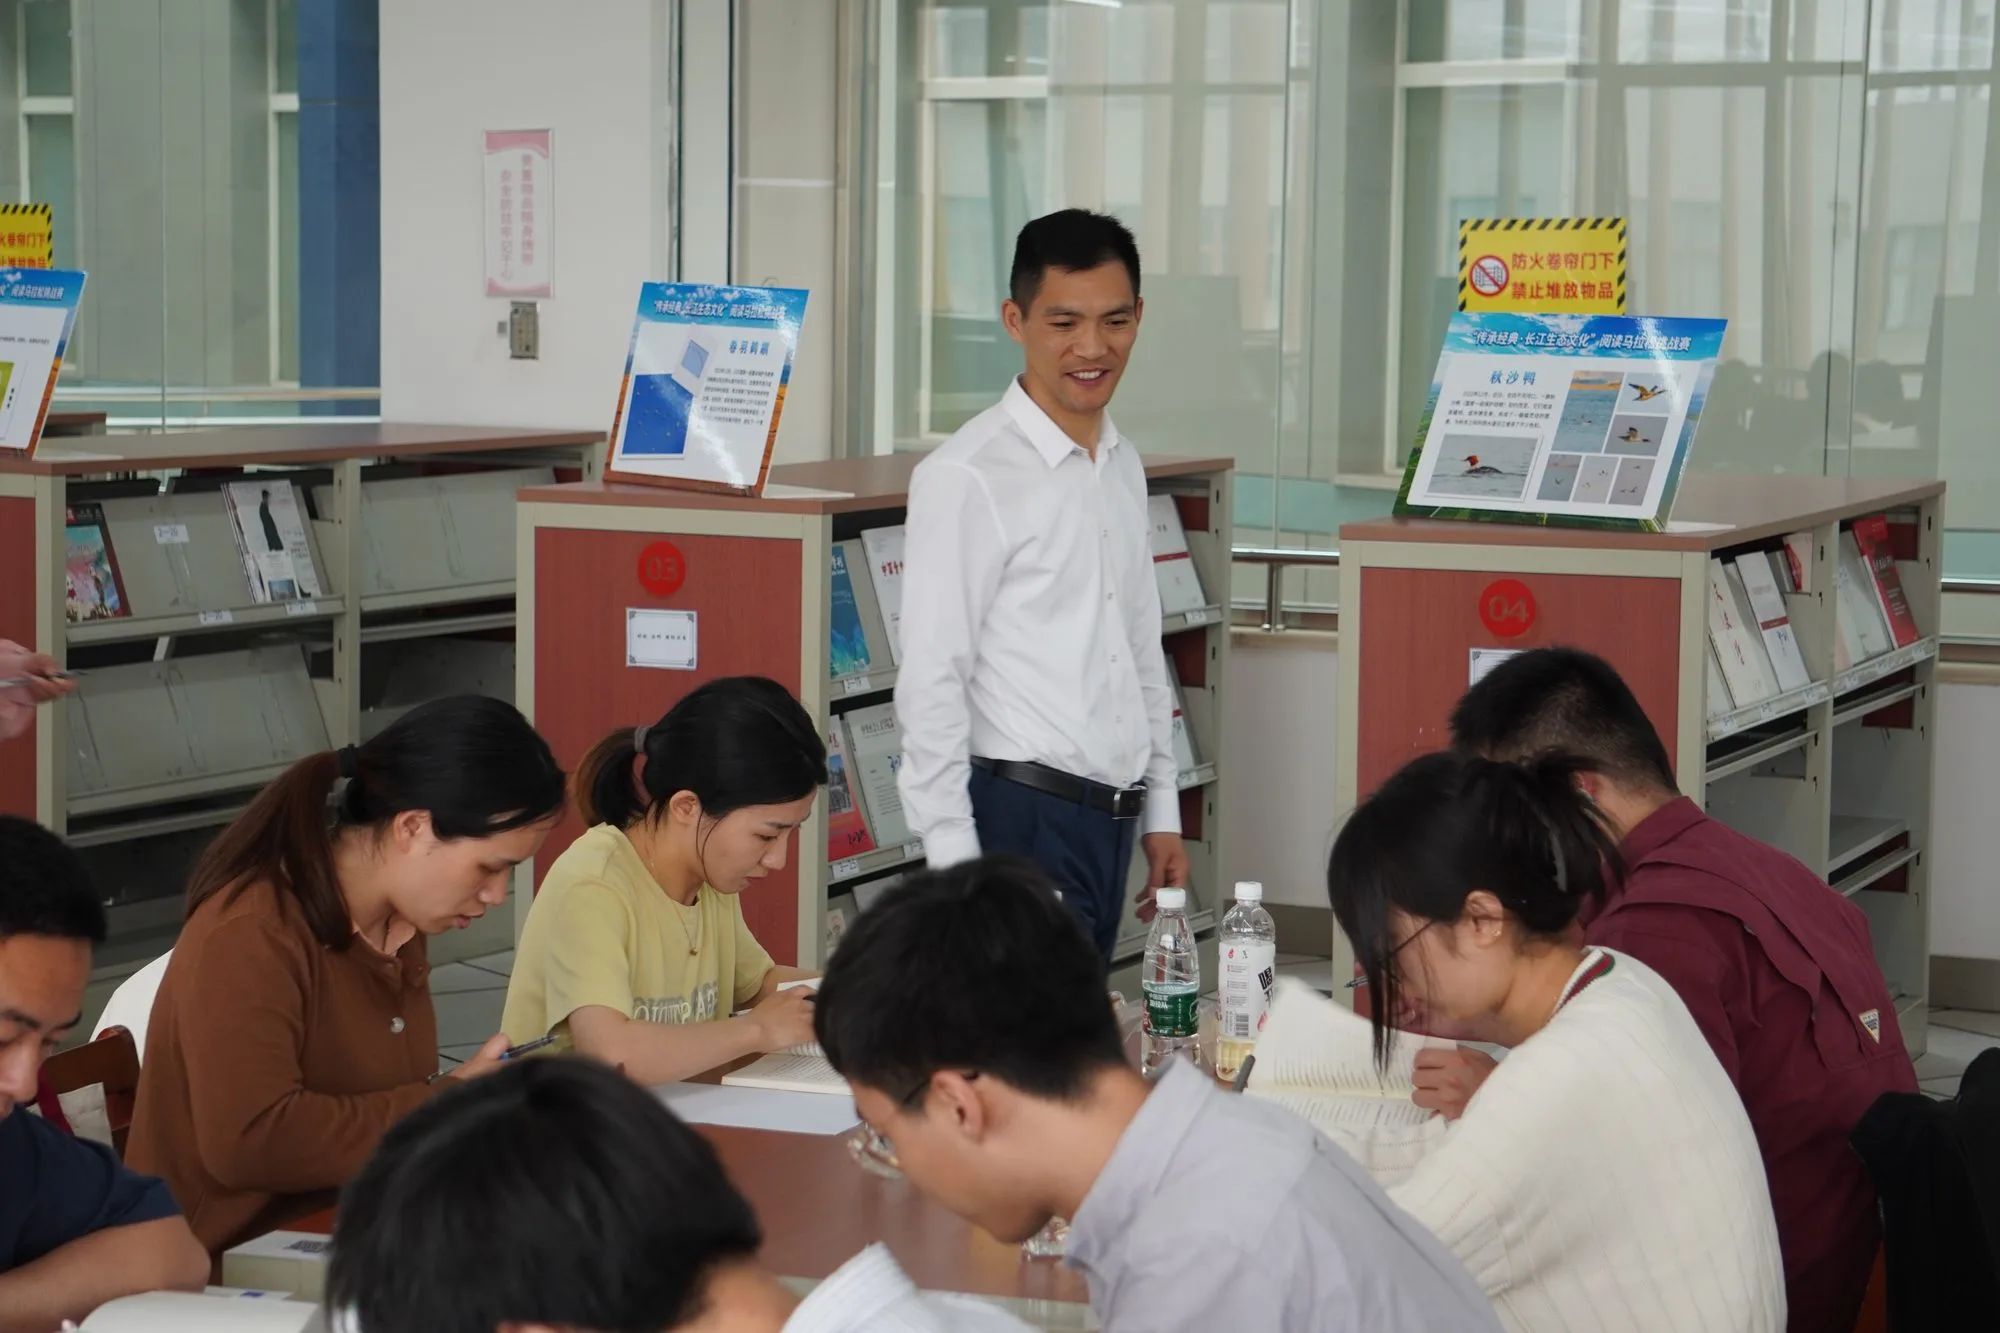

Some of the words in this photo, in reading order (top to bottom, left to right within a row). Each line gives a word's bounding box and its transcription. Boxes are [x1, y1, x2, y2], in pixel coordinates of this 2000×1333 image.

[1511, 252, 1614, 270] 防火卷帘门下
[1511, 282, 1614, 300] 禁止堆放物品
[645, 556, 679, 581] 03
[1488, 594, 1530, 624] 04
